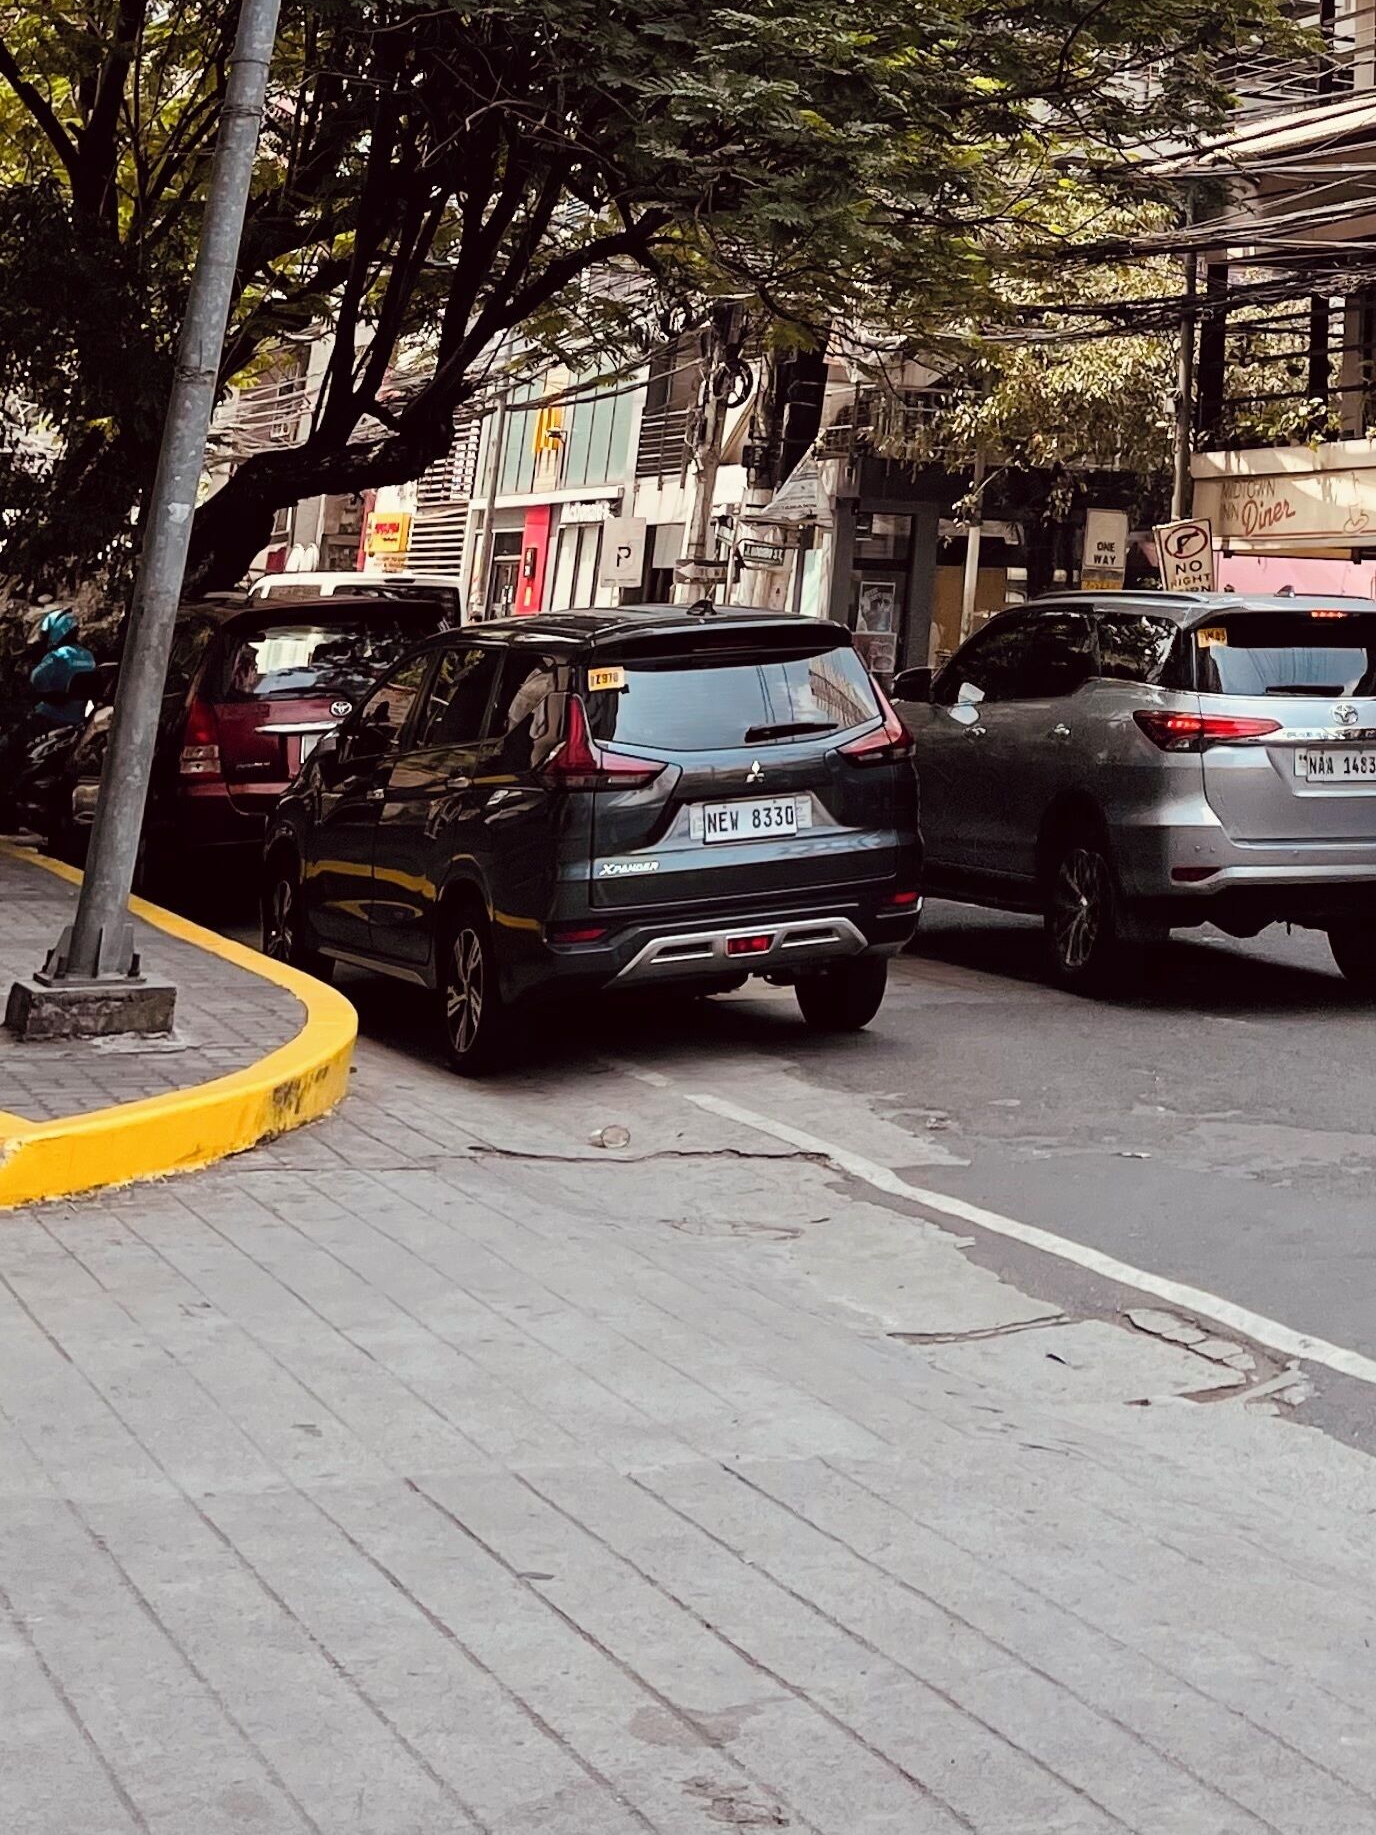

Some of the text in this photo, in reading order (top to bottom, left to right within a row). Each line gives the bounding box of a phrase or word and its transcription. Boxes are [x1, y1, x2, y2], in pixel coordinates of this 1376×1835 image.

[1241, 497, 1297, 537] Diner
[1096, 541, 1116, 552] ONE
[1093, 554, 1117, 566] WAY
[1175, 559, 1203, 576] NO
[1171, 572, 1212, 591] RIGHT
[706, 805, 795, 834] NEW 8330
